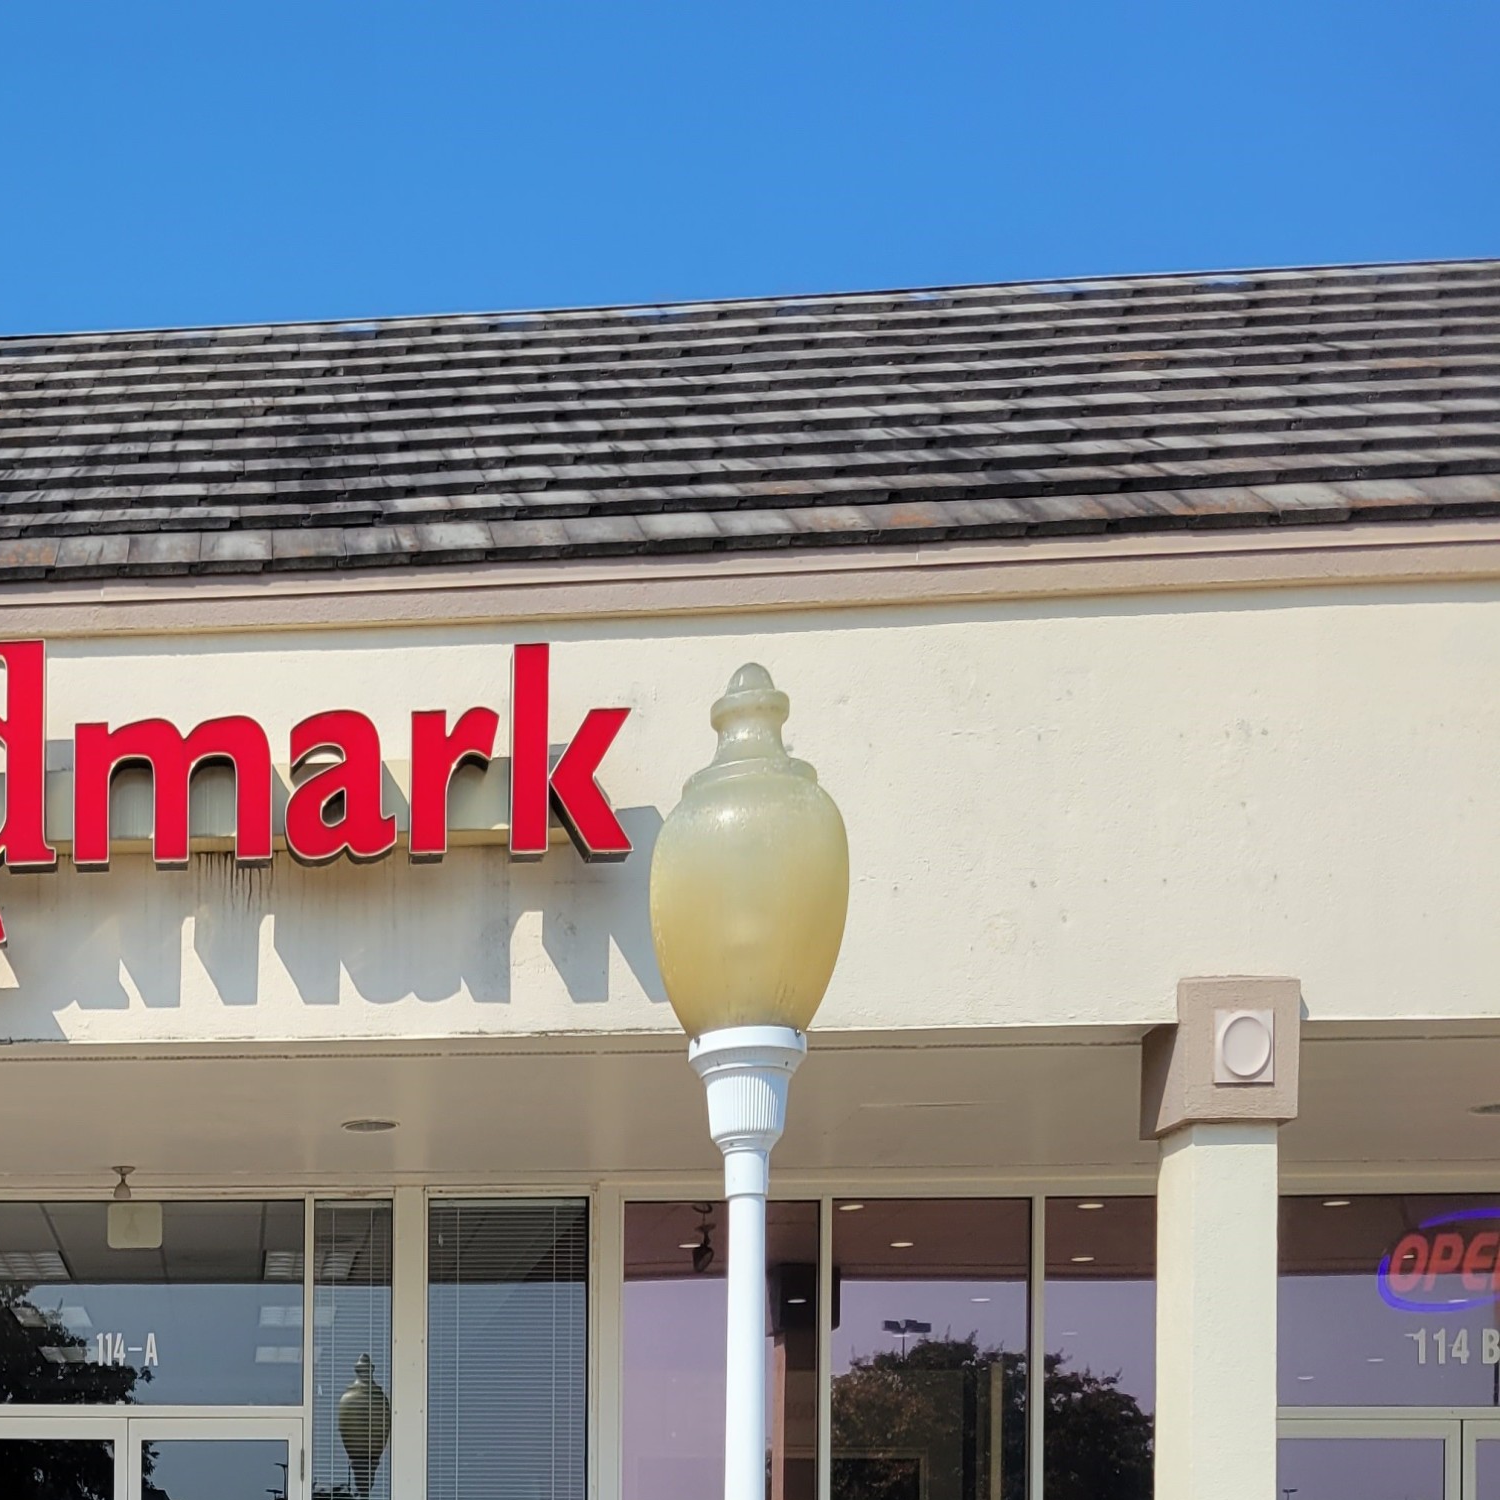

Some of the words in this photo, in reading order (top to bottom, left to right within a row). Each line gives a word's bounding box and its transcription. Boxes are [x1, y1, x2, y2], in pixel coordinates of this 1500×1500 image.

[1389, 1231, 1500, 1294] OPE
[96, 1332, 159, 1367] 114-A
[1412, 1328, 1470, 1365] 114
[1482, 1328, 1500, 1365] B
